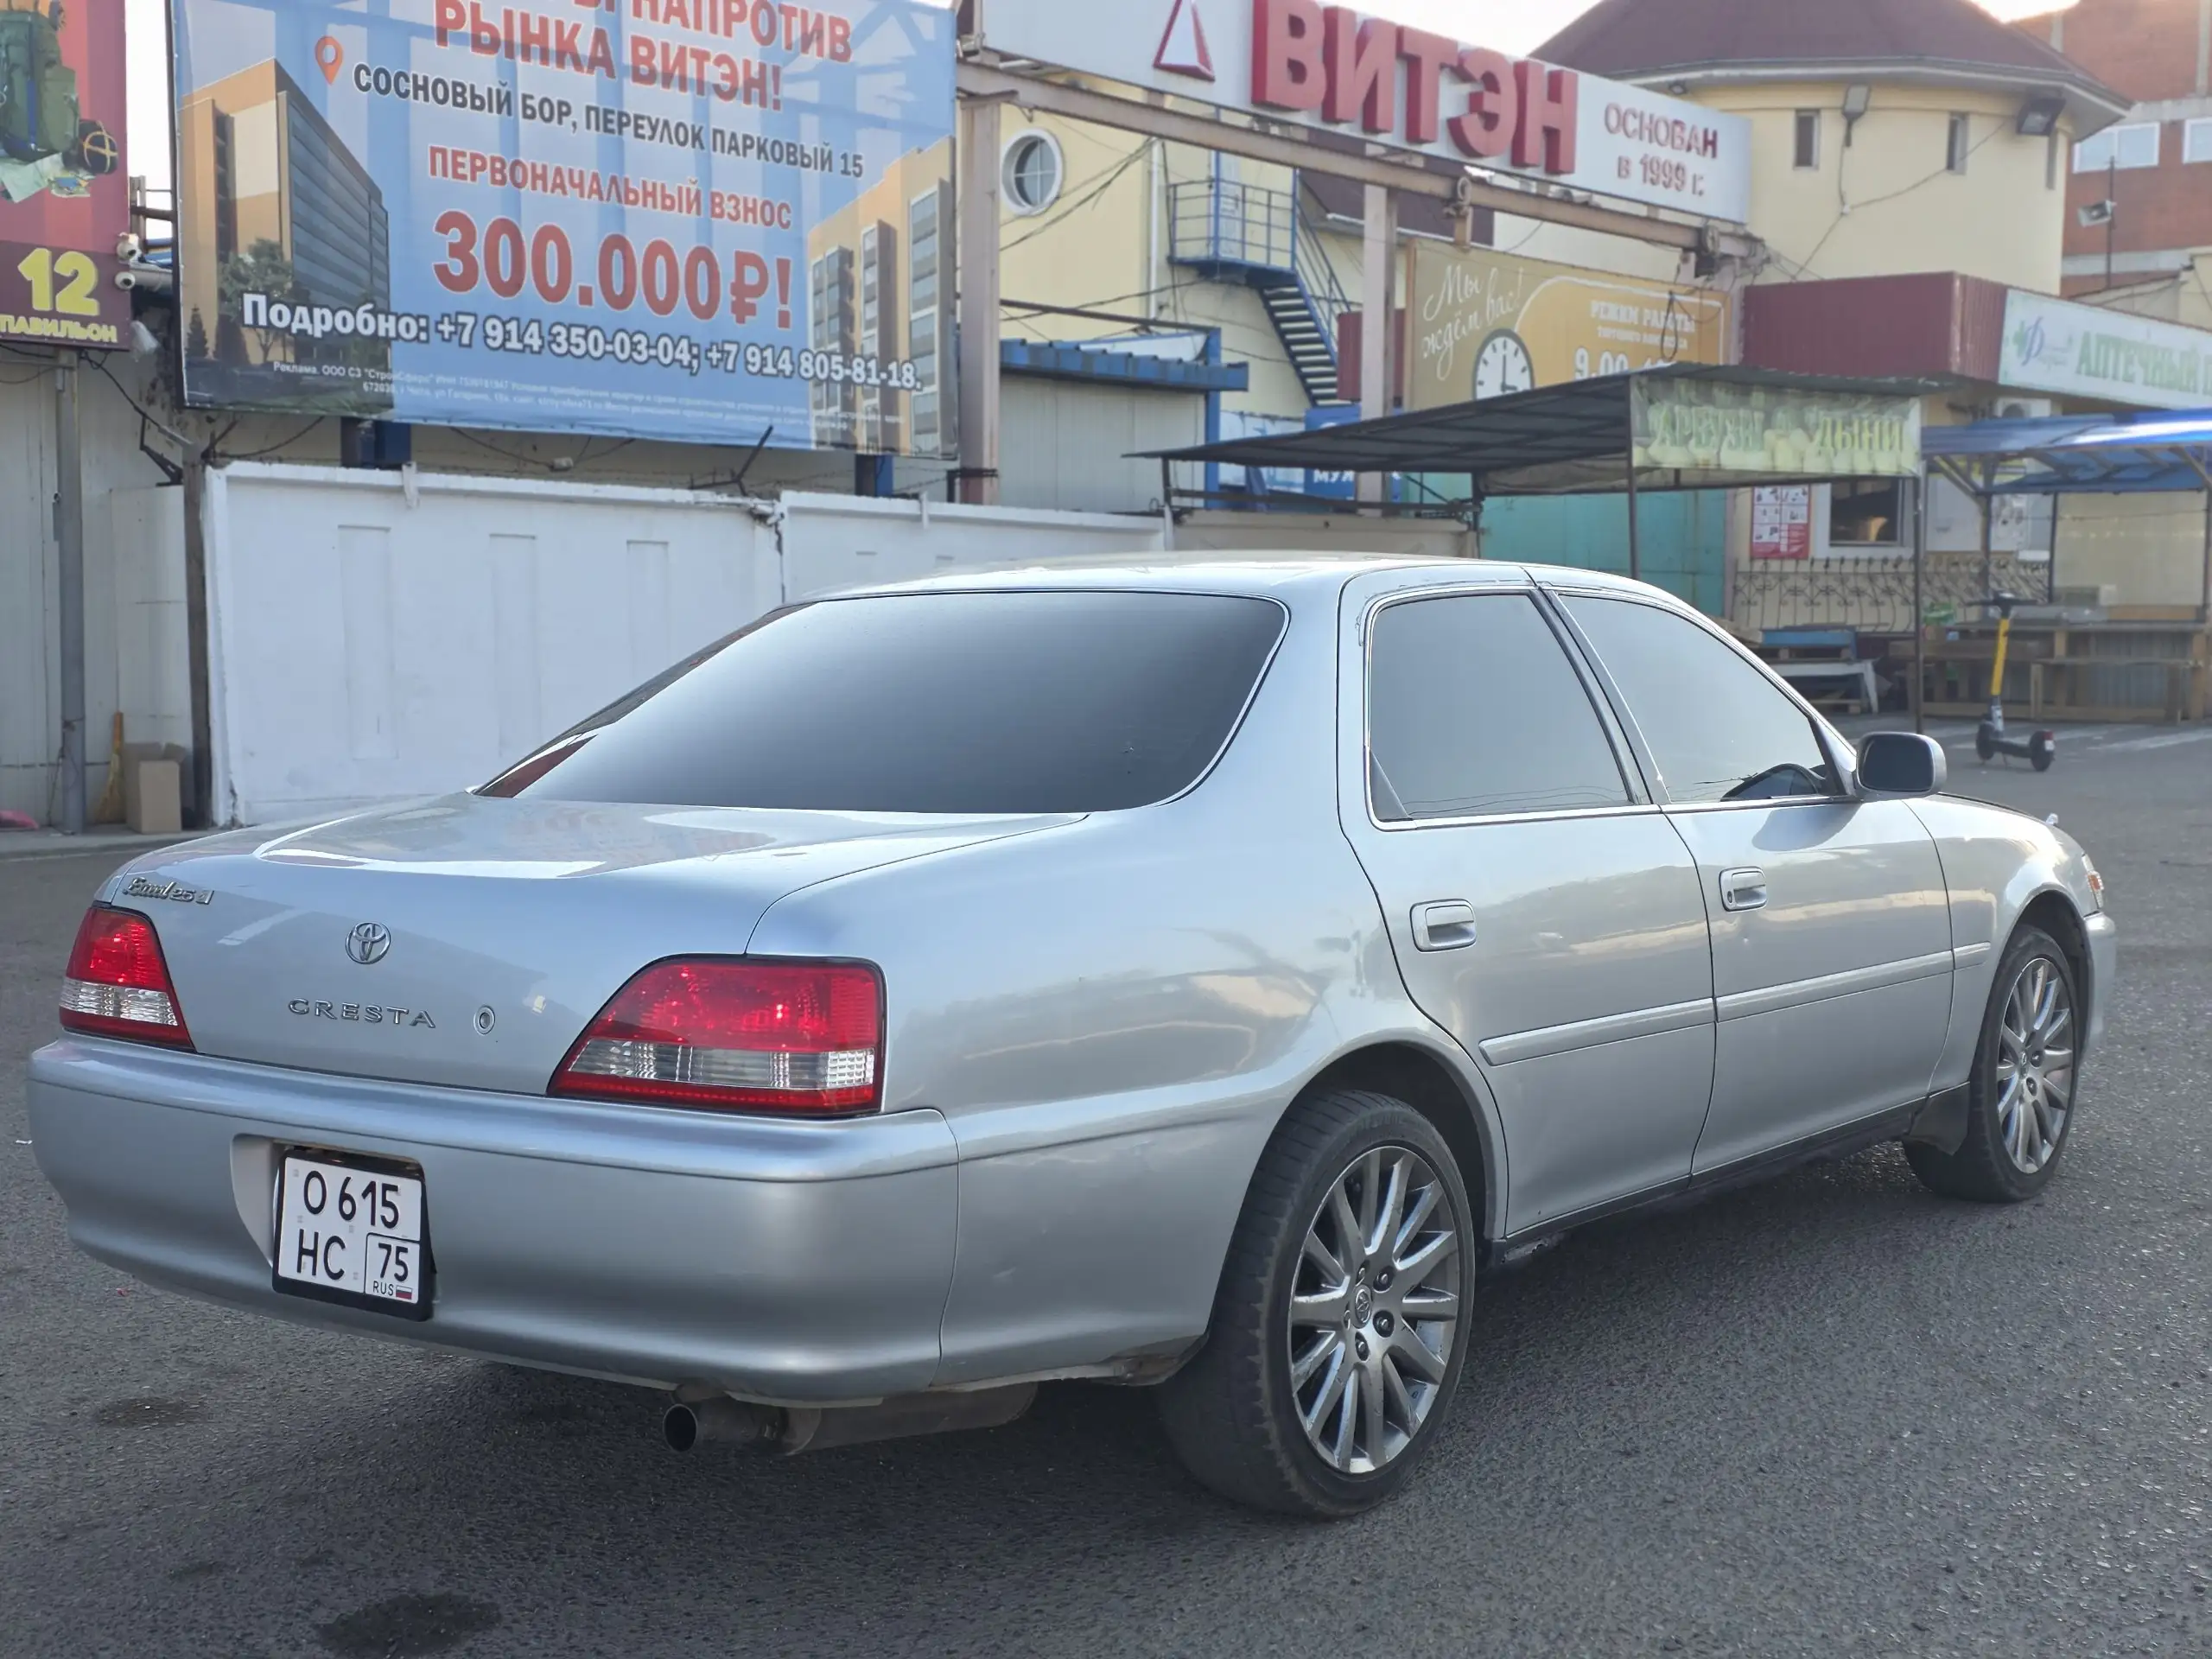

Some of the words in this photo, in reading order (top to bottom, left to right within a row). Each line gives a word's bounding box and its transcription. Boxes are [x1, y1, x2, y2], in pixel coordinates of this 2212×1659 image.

[435, 0, 616, 79] РЫНКА
[631, 35, 782, 111] ВИТЭН!
[1251, 0, 1579, 175] ВИТЭН
[353, 63, 512, 118] СОСНОВЫЙ
[521, 92, 577, 132] БОР,
[585, 105, 705, 151] ПЕРЕУЛОК
[712, 128, 834, 173] ПАРКОВЫЙ
[840, 153, 864, 178] 15
[1604, 102, 1718, 160] ОСНОВАН
[429, 145, 702, 217] ПЕРВОНАЧАЛЬНЫЙ
[709, 190, 791, 230] ВЗНОС
[1638, 153, 1686, 193] 1999
[17, 247, 101, 317] 12
[1423, 264, 1484, 321] Мы
[0, 313, 118, 344] ПАВИЛЬОН
[242, 292, 429, 340] Подробно:
[436, 315, 474, 346] +7
[482, 315, 543, 353] 914
[548, 321, 699, 375] 350-03-04;
[706, 341, 740, 372] +7
[745, 346, 794, 378] 914
[798, 348, 925, 391] 805-81-18.
[321, 365, 346, 377] ООО
[2075, 330, 2201, 394] АПТЕЧНЫЙ
[1815, 416, 1903, 455] ДЫНИ
[288, 997, 435, 1029] CRESTA
[338, 1176, 399, 1229] 615
[296, 1228, 346, 1281] НС
[378, 1242, 409, 1282] 75
[372, 1280, 394, 1297] RUS
